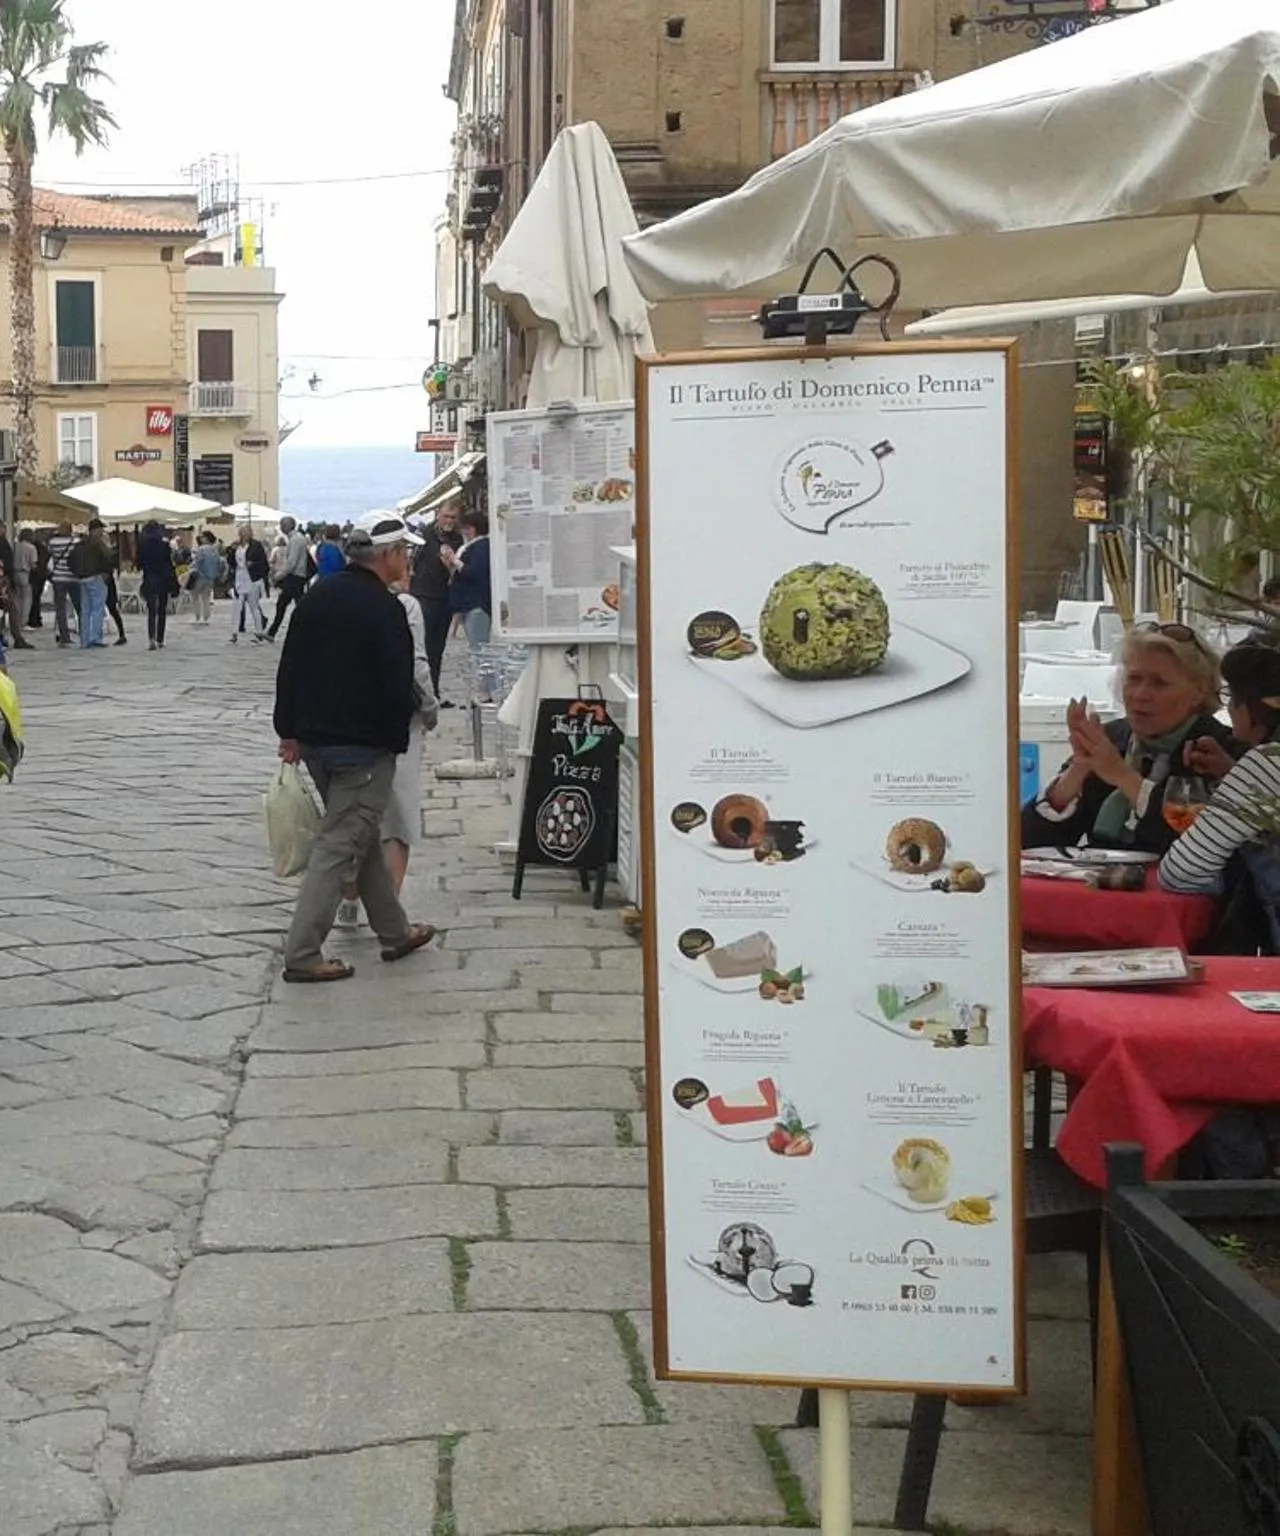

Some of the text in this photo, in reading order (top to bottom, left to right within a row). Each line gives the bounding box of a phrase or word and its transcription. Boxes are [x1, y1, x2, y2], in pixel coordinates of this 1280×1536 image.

[670, 384, 682, 403] Il
[689, 382, 767, 403] Tartufo
[773, 380, 792, 399] di
[801, 376, 910, 399] Domenico
[149, 409, 172, 432] illy
[117, 451, 160, 460] MARTINI
[912, 1256, 944, 1268] prima
